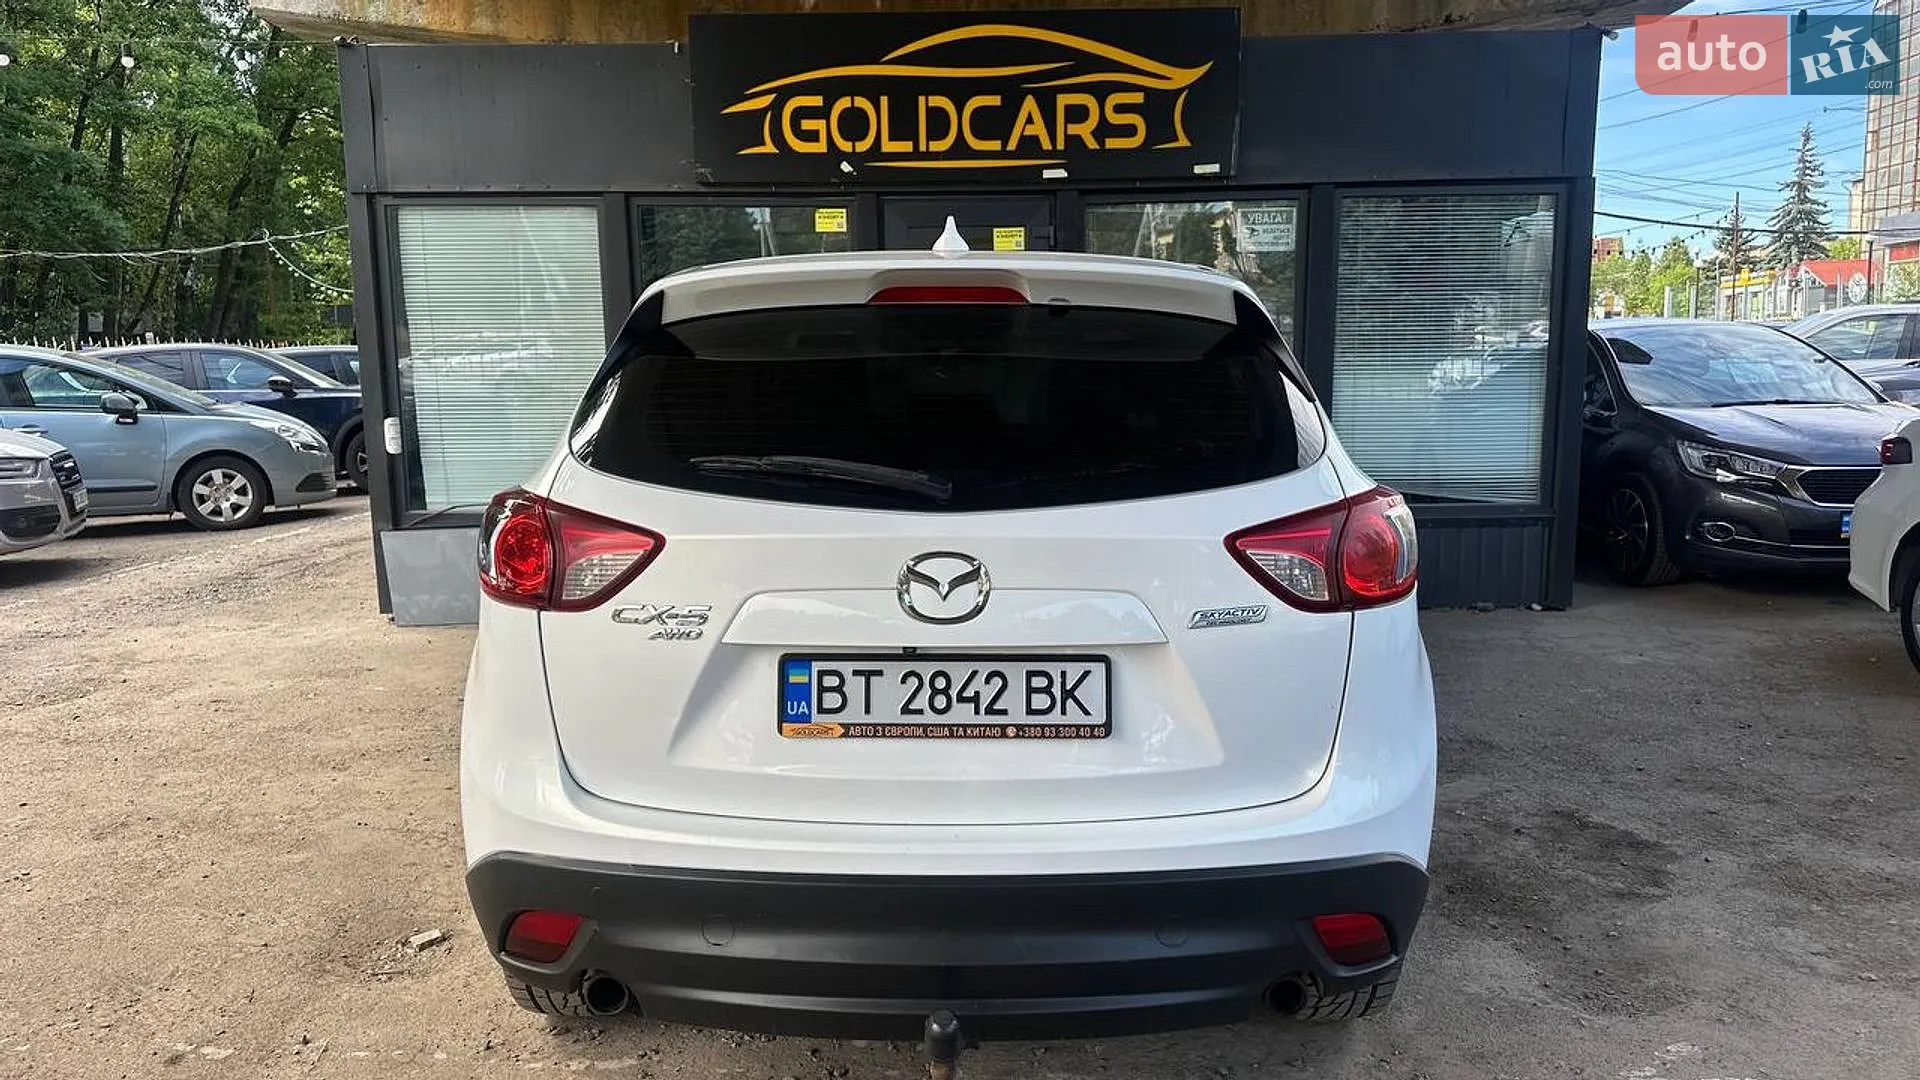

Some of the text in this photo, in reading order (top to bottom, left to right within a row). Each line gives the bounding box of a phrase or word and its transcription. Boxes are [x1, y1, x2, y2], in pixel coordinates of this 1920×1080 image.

[781, 91, 1147, 153] GOLDCARS
[1247, 212, 1287, 224] УВАГА!
[611, 604, 712, 626] CX-5
[1199, 606, 1263, 620] SKYACTIV
[648, 627, 704, 640] AWD
[815, 668, 1093, 717] BT 2842 BK
[787, 700, 809, 716] UA
[850, 726, 875, 737] АВТО
[927, 726, 950, 737] США
[953, 726, 965, 737] ТА
[966, 726, 1000, 737] КИТАЮ
[1044, 726, 1056, 737] 93
[1078, 726, 1091, 737] 40
